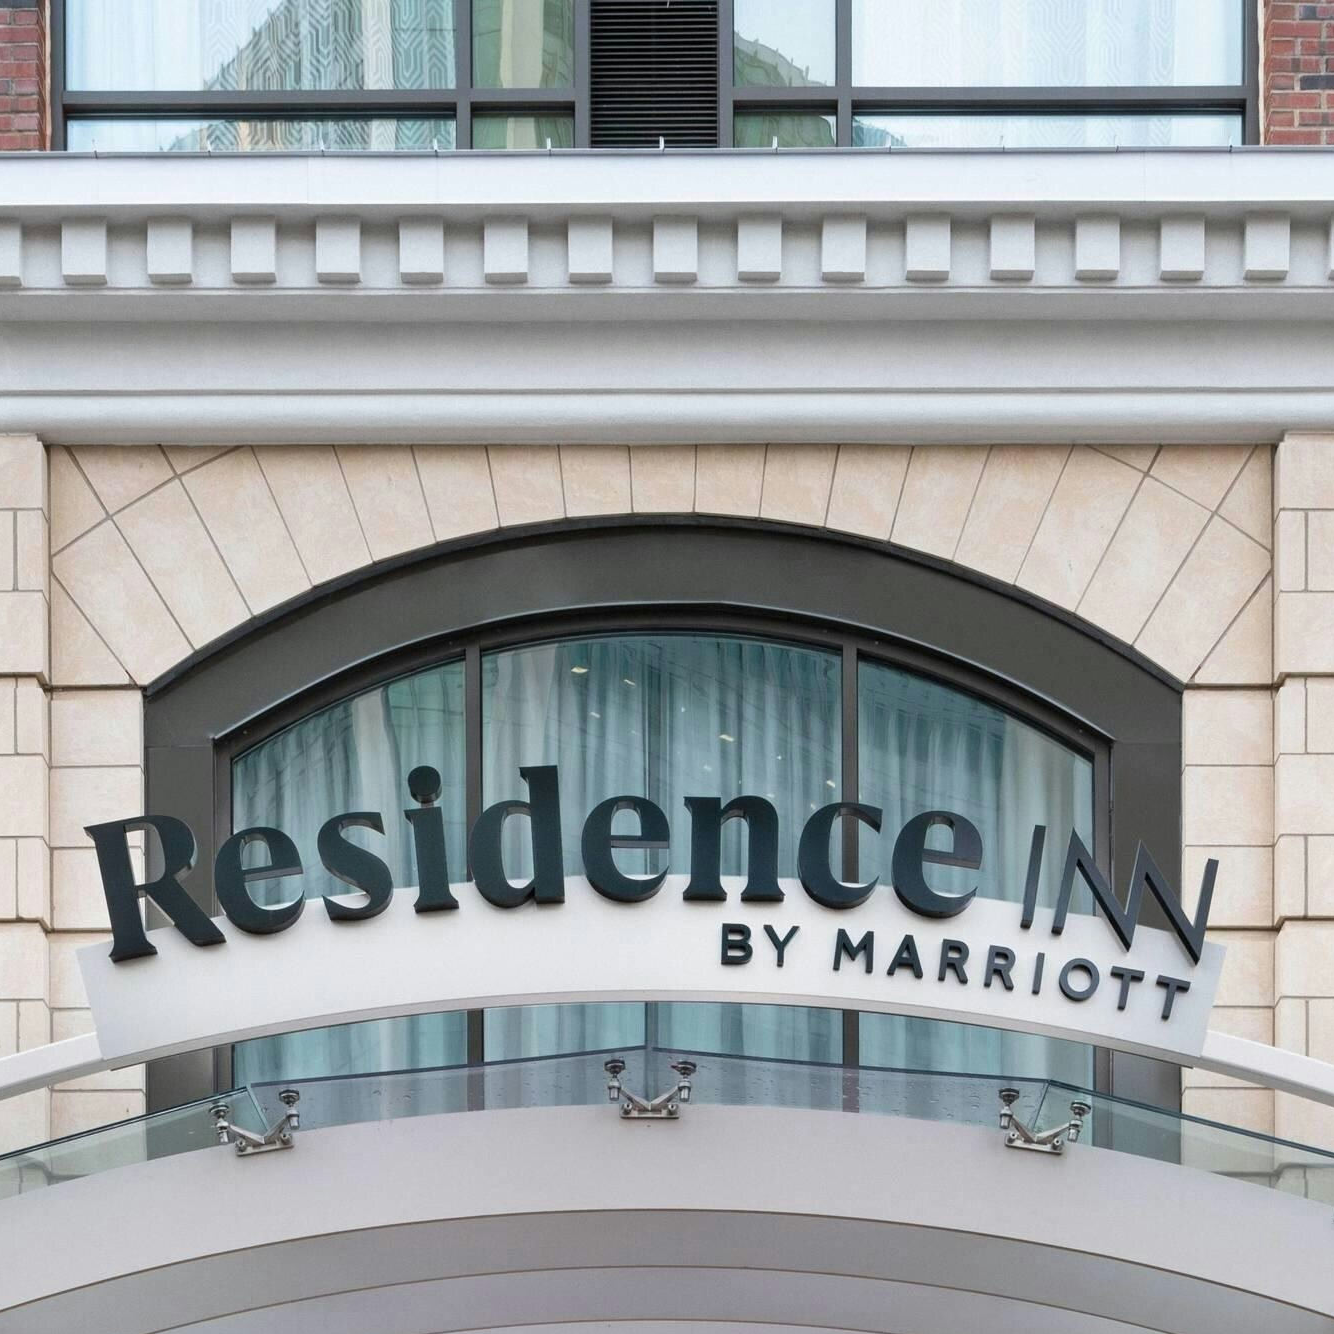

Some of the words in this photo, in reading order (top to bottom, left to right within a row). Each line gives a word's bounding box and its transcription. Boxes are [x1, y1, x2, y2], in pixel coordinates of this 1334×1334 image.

[83, 765, 983, 963] Residence
[1020, 824, 1219, 966] INN
[720, 923, 801, 968] BY
[833, 928, 1191, 1020] MARRIOTT
